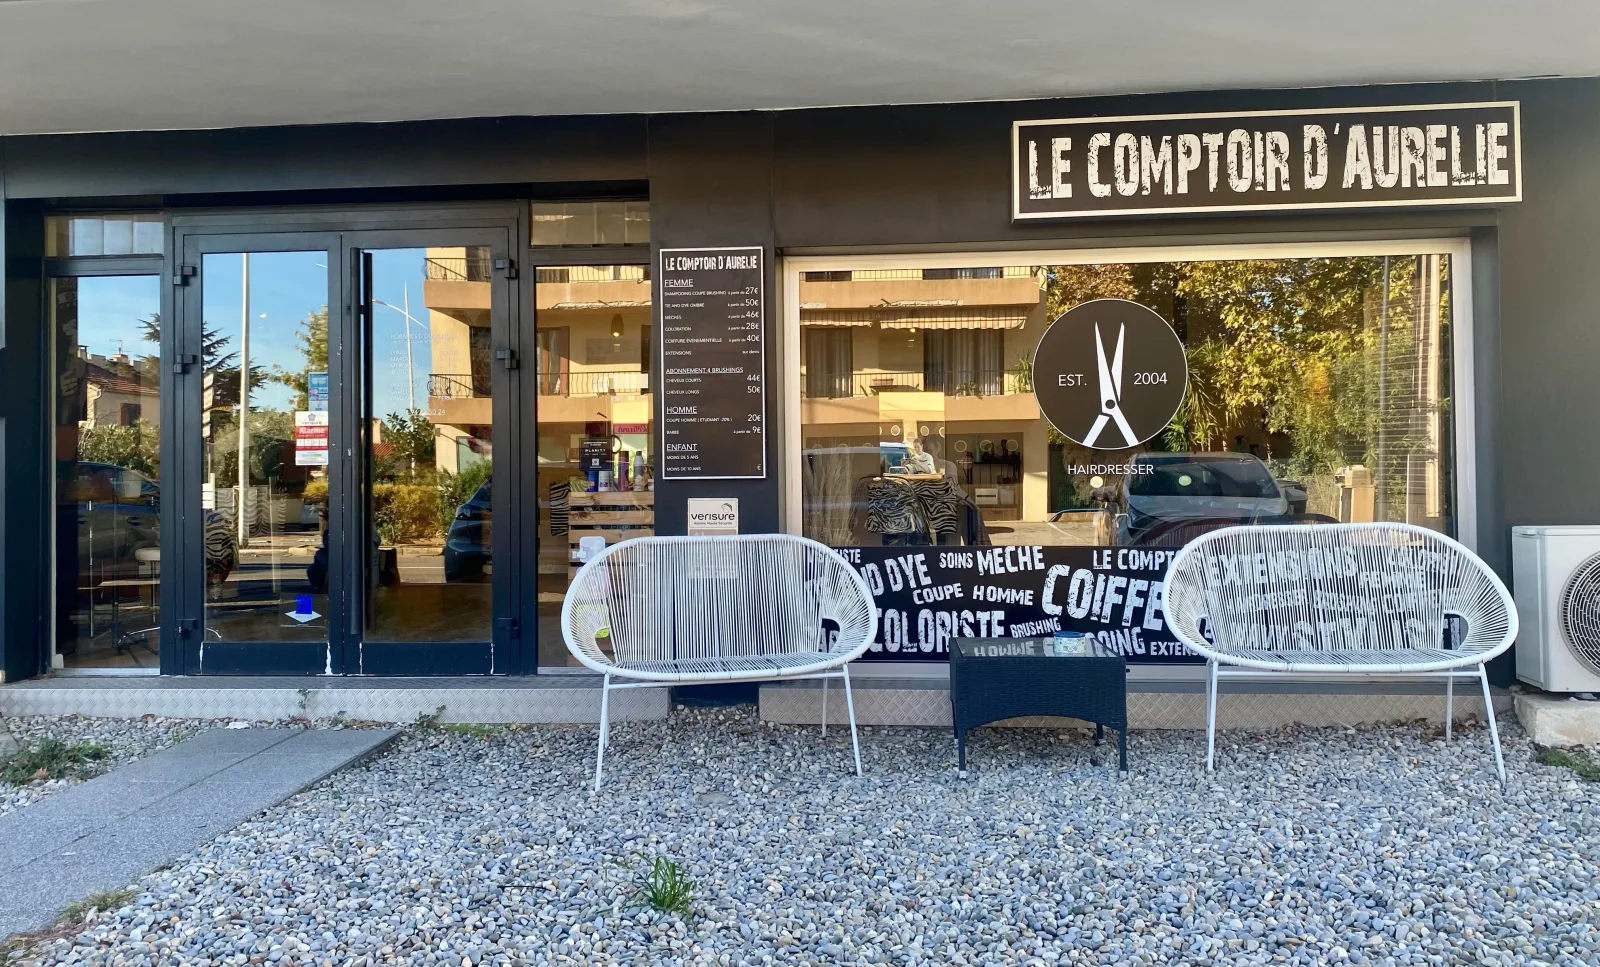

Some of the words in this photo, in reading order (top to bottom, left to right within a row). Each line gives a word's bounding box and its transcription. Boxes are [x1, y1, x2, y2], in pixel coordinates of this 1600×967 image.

[1029, 137, 1073, 199] LE
[1087, 128, 1291, 198] COMPTOIR
[1303, 122, 1509, 191] D'AURELIE
[666, 257, 675, 270] LE
[676, 256, 716, 270] COMPTOIR
[718, 256, 758, 270] D'AURELIE
[664, 278, 694, 287] FEMME
[1058, 374, 1088, 386] EST.
[1134, 372, 1168, 385] 2004
[1067, 464, 1154, 475] HAIRDRESSER
[939, 552, 974, 569] SOINS
[976, 545, 1046, 576] MECHE
[1093, 550, 1112, 570] LE
[1117, 549, 1181, 570] COMPT
[884, 553, 932, 592] DYE
[912, 583, 964, 605] COUPE
[972, 585, 1034, 606] HOMME
[1042, 564, 1164, 632] COIFFE
[1010, 617, 1062, 639] BRUSHING
